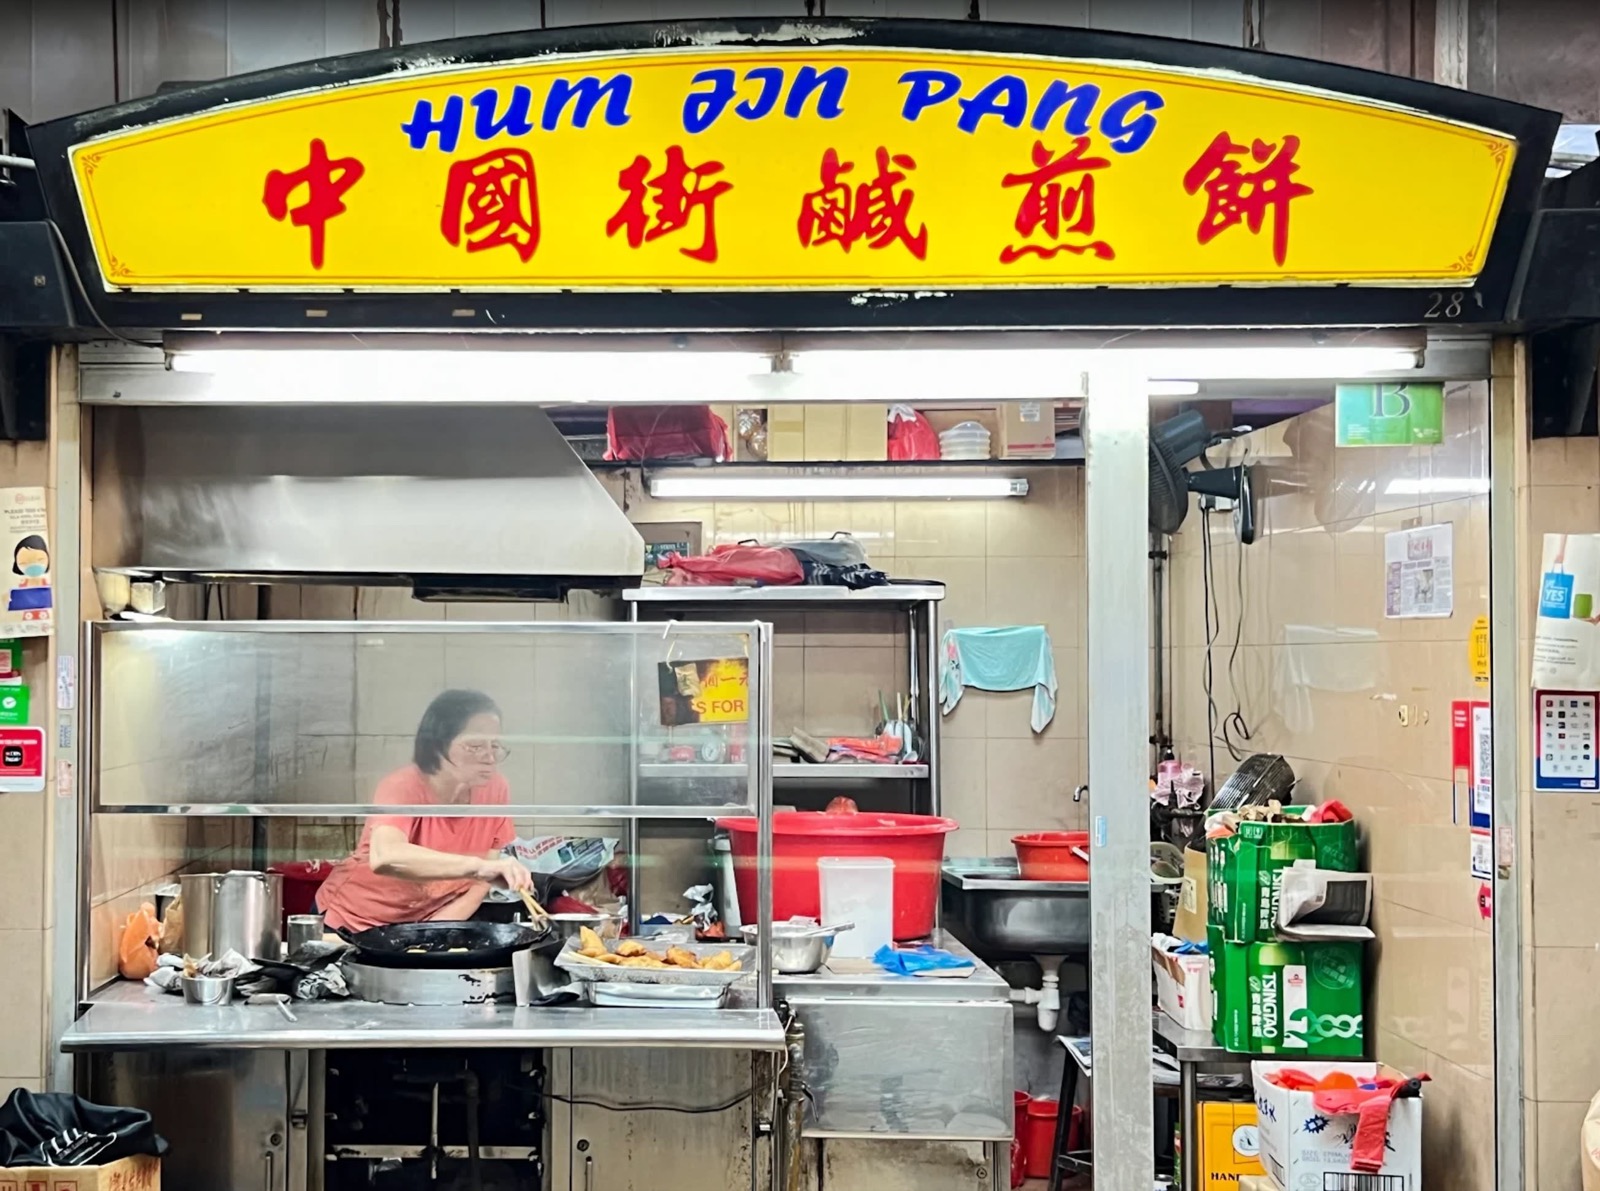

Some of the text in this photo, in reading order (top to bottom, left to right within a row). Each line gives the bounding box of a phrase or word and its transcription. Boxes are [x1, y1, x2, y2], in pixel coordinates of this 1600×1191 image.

[402, 74, 632, 152] HUM
[900, 70, 1164, 153] PANG
[263, 134, 1310, 267] 中國街鹹煎餅
[1424, 291, 1464, 318] 28
[1369, 383, 1412, 419] B
[1545, 589, 1565, 602] YES
[712, 699, 744, 713] FOR
[1262, 972, 1278, 1038] TSINGTAO
